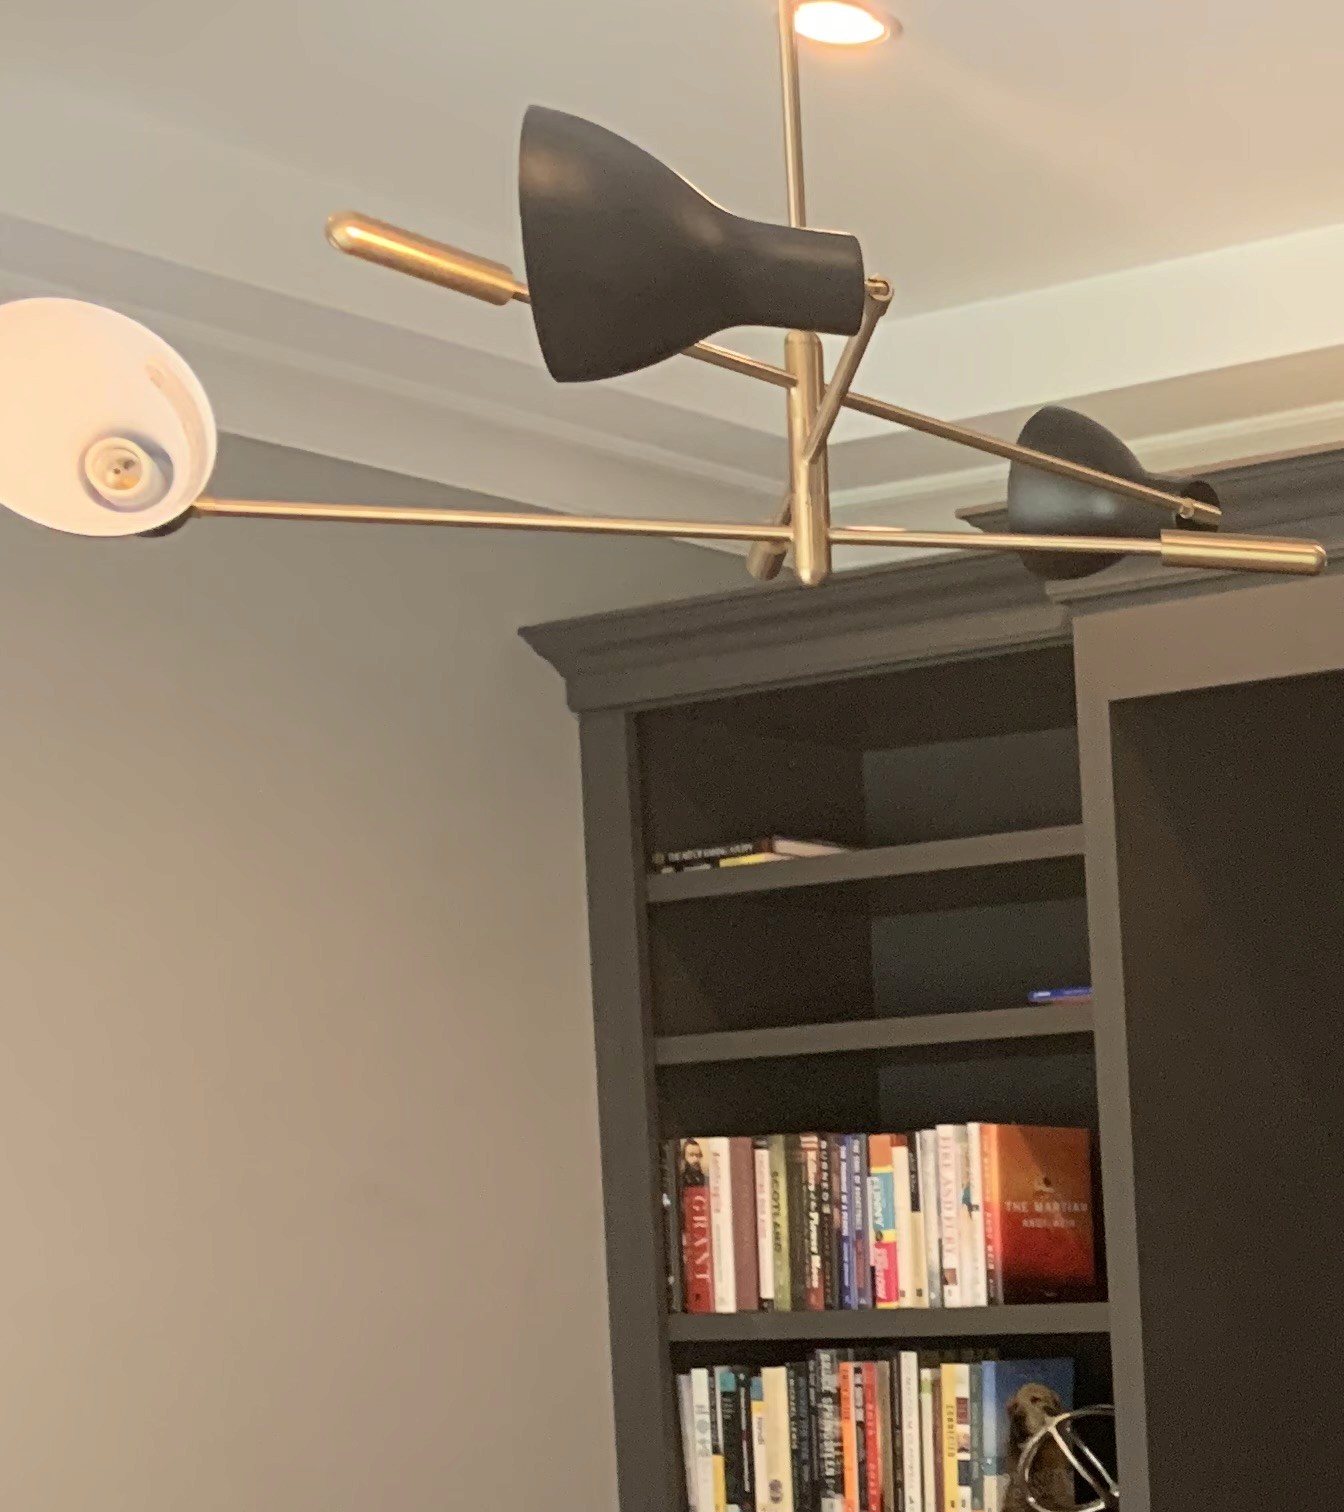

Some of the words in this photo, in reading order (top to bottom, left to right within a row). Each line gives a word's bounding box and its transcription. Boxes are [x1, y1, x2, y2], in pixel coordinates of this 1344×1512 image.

[693, 1195, 711, 1283] GRANT
[771, 1171, 782, 1253] SCOTLAND
[1005, 1201, 1029, 1212] THE
[1034, 1201, 1088, 1213] MARTIAN
